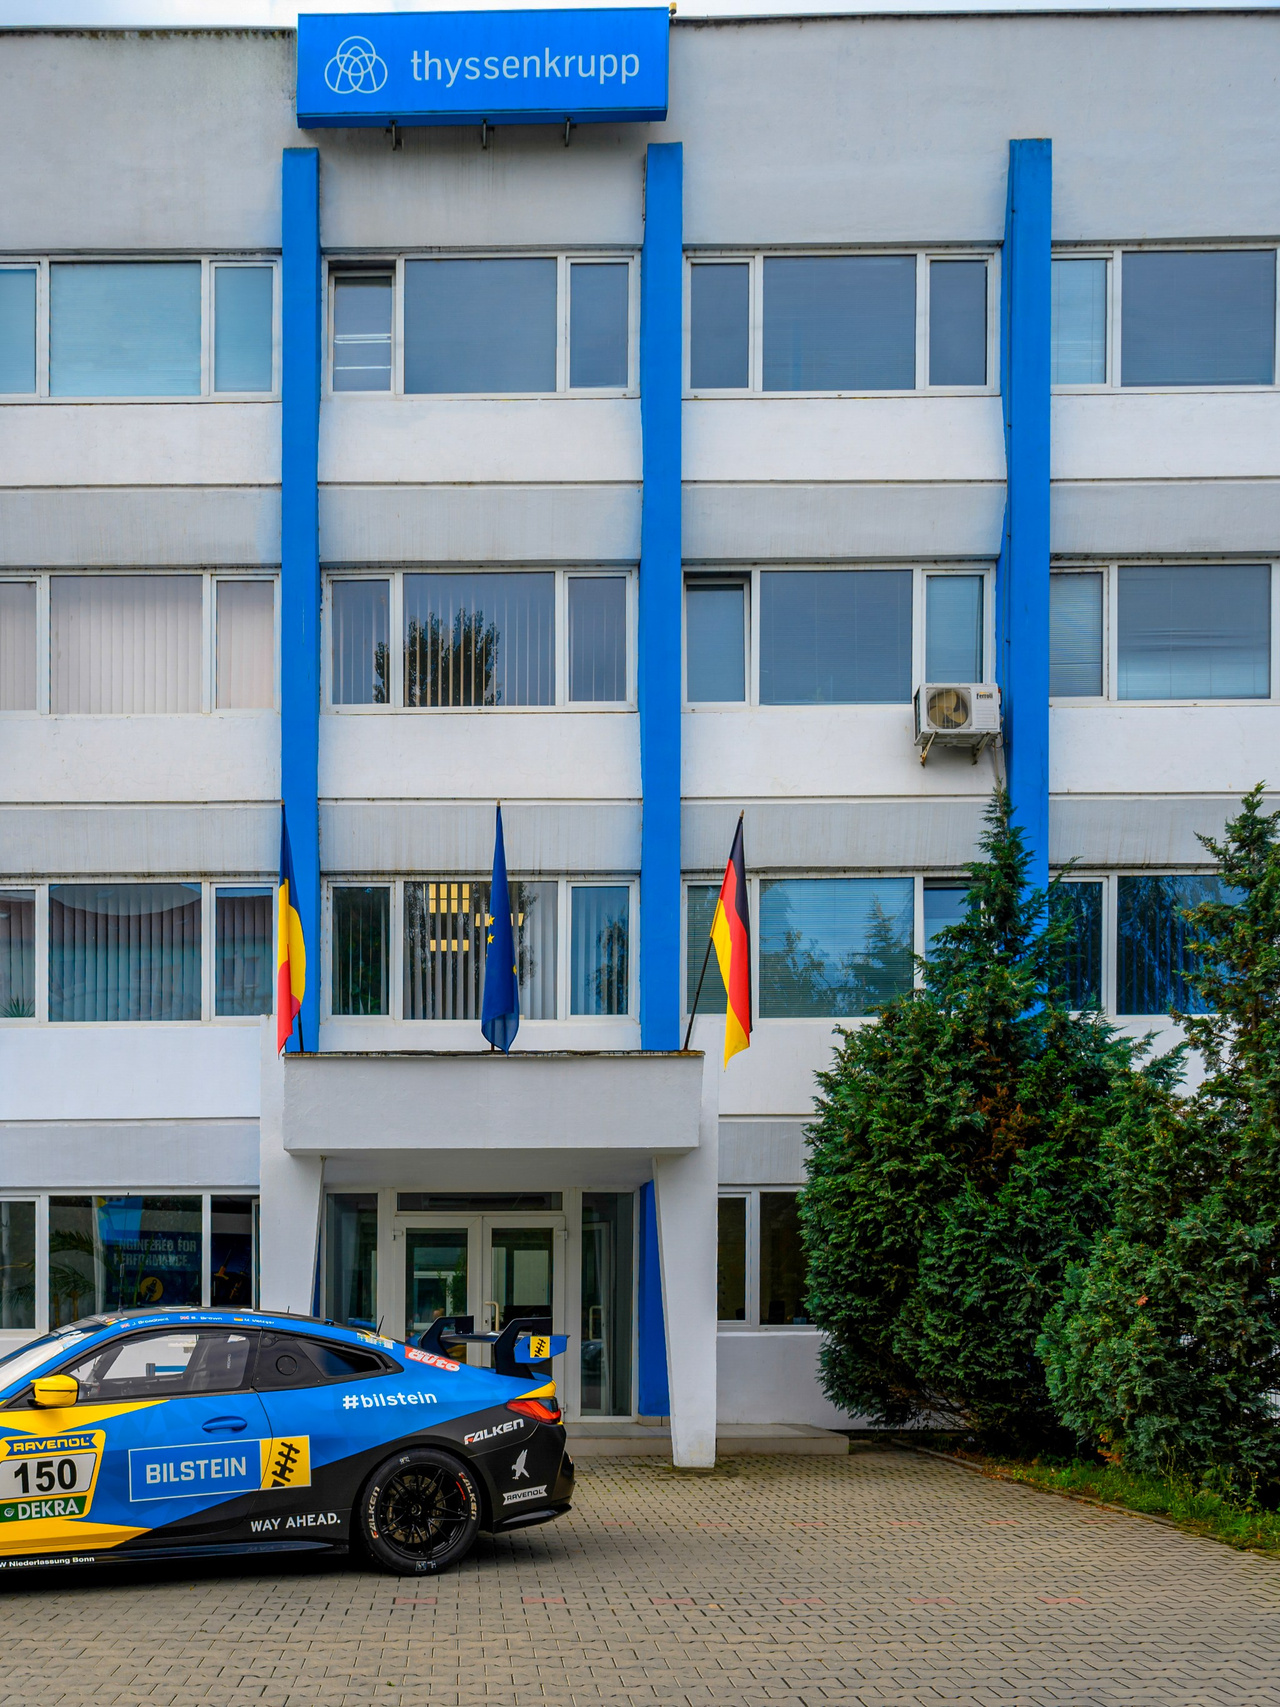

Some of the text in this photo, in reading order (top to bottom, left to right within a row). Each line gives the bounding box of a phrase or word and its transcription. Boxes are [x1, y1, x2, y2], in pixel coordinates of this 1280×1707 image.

[410, 47, 640, 88] thyssenkrupp
[177, 1238, 197, 1252] FOR
[408, 1351, 460, 1372] auto
[342, 1391, 438, 1410] #bilstein
[463, 1418, 525, 1445] FALKEN
[13, 1437, 90, 1452] RAVENOL
[14, 1458, 77, 1494] 150
[145, 1456, 247, 1485] BILSTEIN
[458, 1471, 478, 1520] FALKEN
[506, 1488, 543, 1502] RAVENOL
[18, 1498, 79, 1520] DEKRA
[368, 1486, 380, 1539] FALKEN
[250, 1513, 341, 1533] WAY AHEAD.
[9, 1557, 70, 1568] Niederlassung
